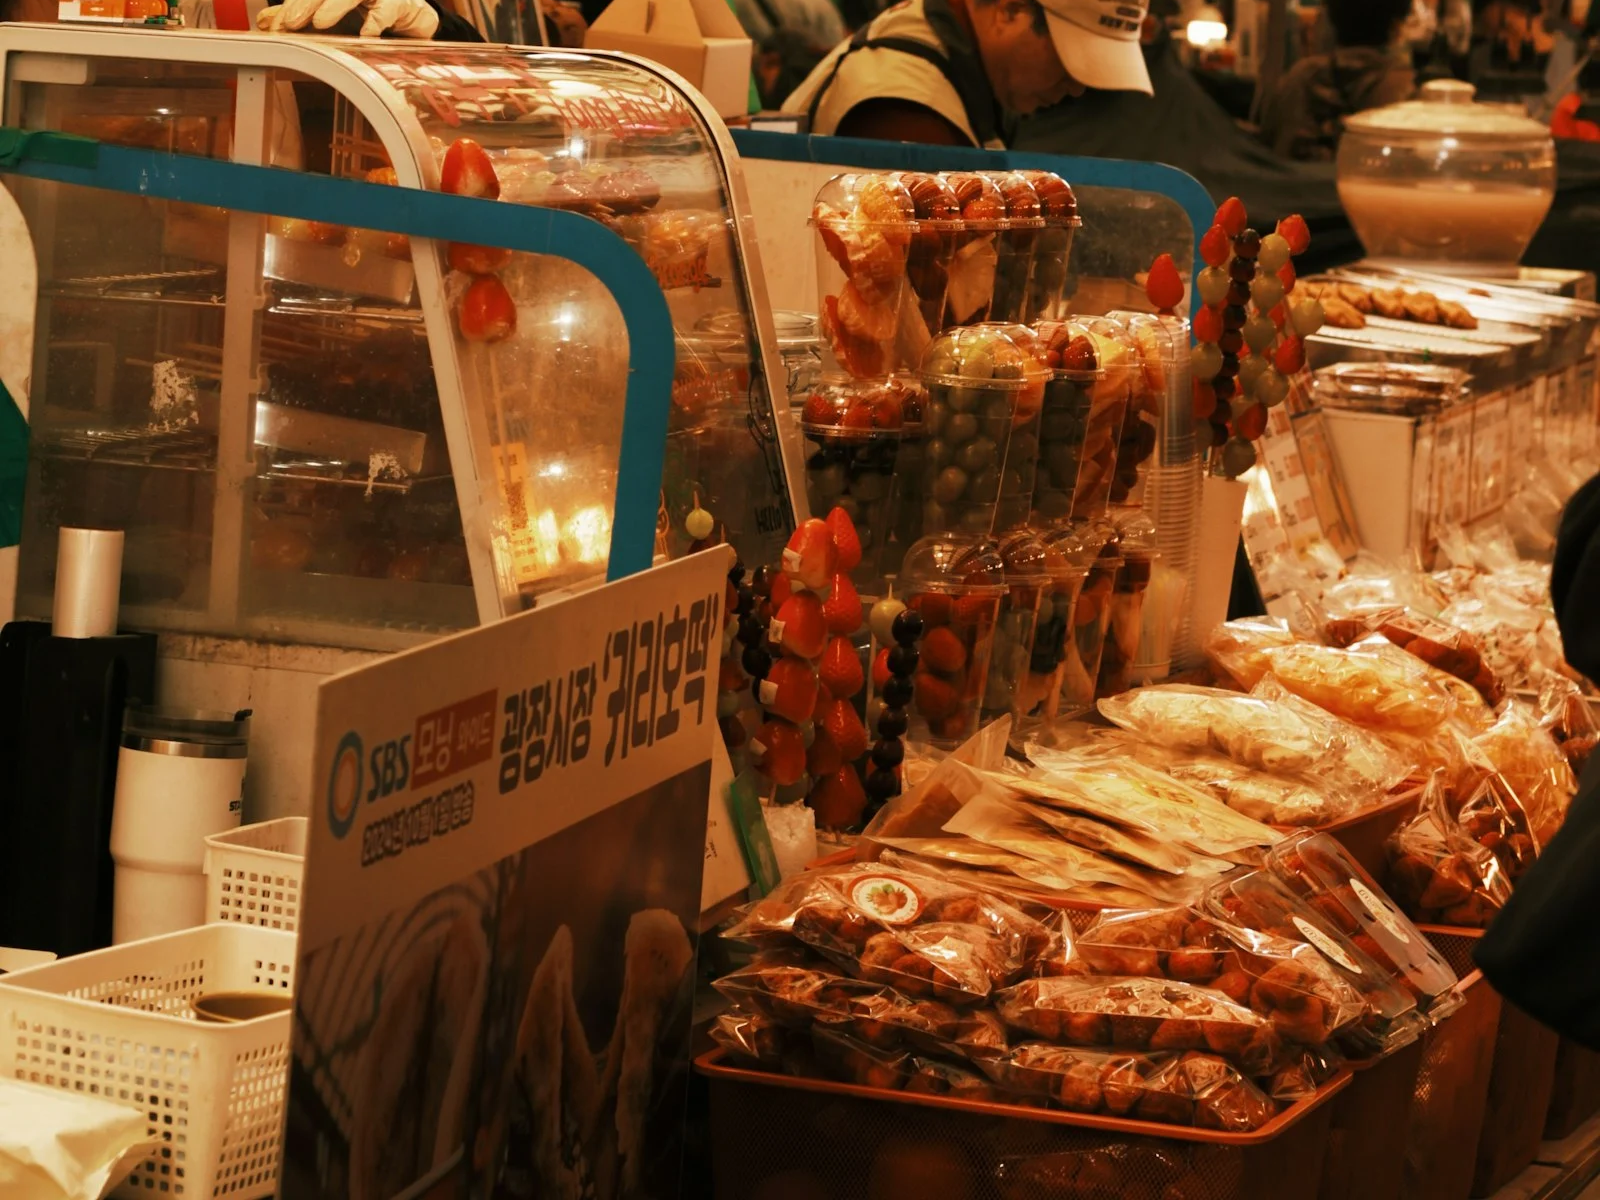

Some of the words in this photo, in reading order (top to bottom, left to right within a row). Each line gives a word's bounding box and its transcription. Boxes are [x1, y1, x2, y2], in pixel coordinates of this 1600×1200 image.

[367, 733, 413, 802] SBS
[414, 712, 455, 775] 모닝
[456, 711, 492, 755] 와이드
[498, 661, 597, 795] 광장시장
